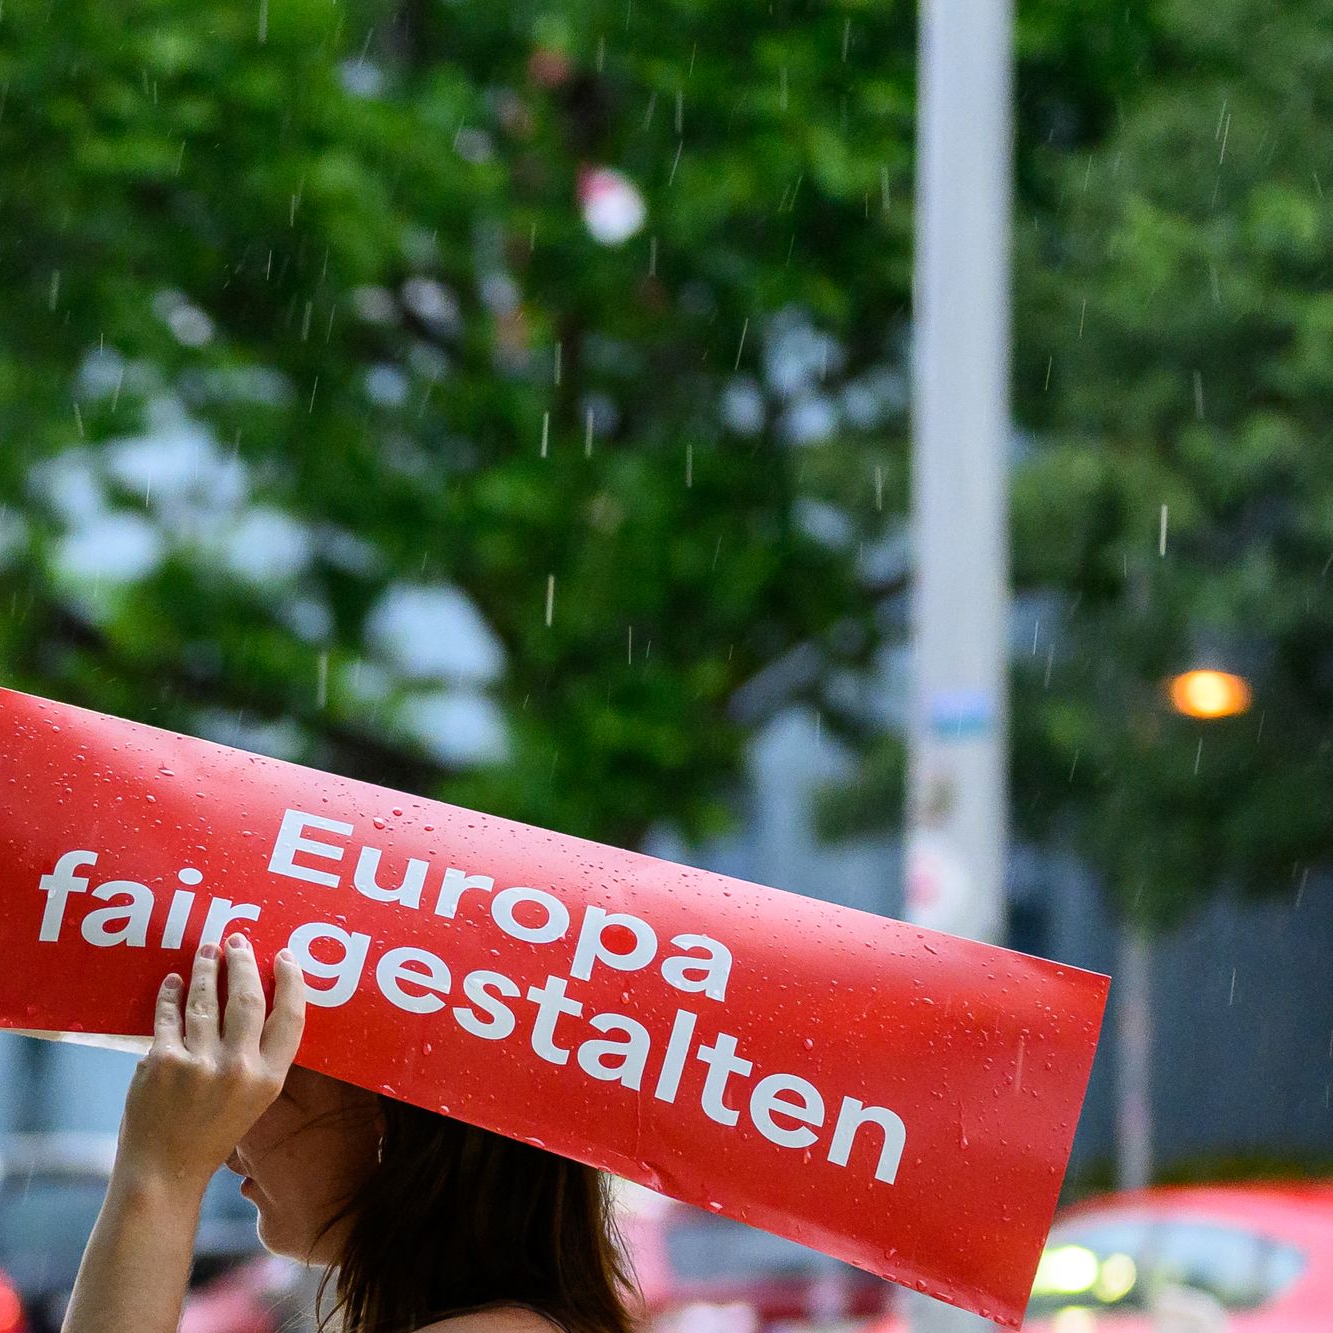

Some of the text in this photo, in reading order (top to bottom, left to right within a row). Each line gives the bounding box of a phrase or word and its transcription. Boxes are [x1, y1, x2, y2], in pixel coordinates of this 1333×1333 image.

[38, 849, 906, 1185] fair gestalten
[268, 809, 733, 1002] Europa
